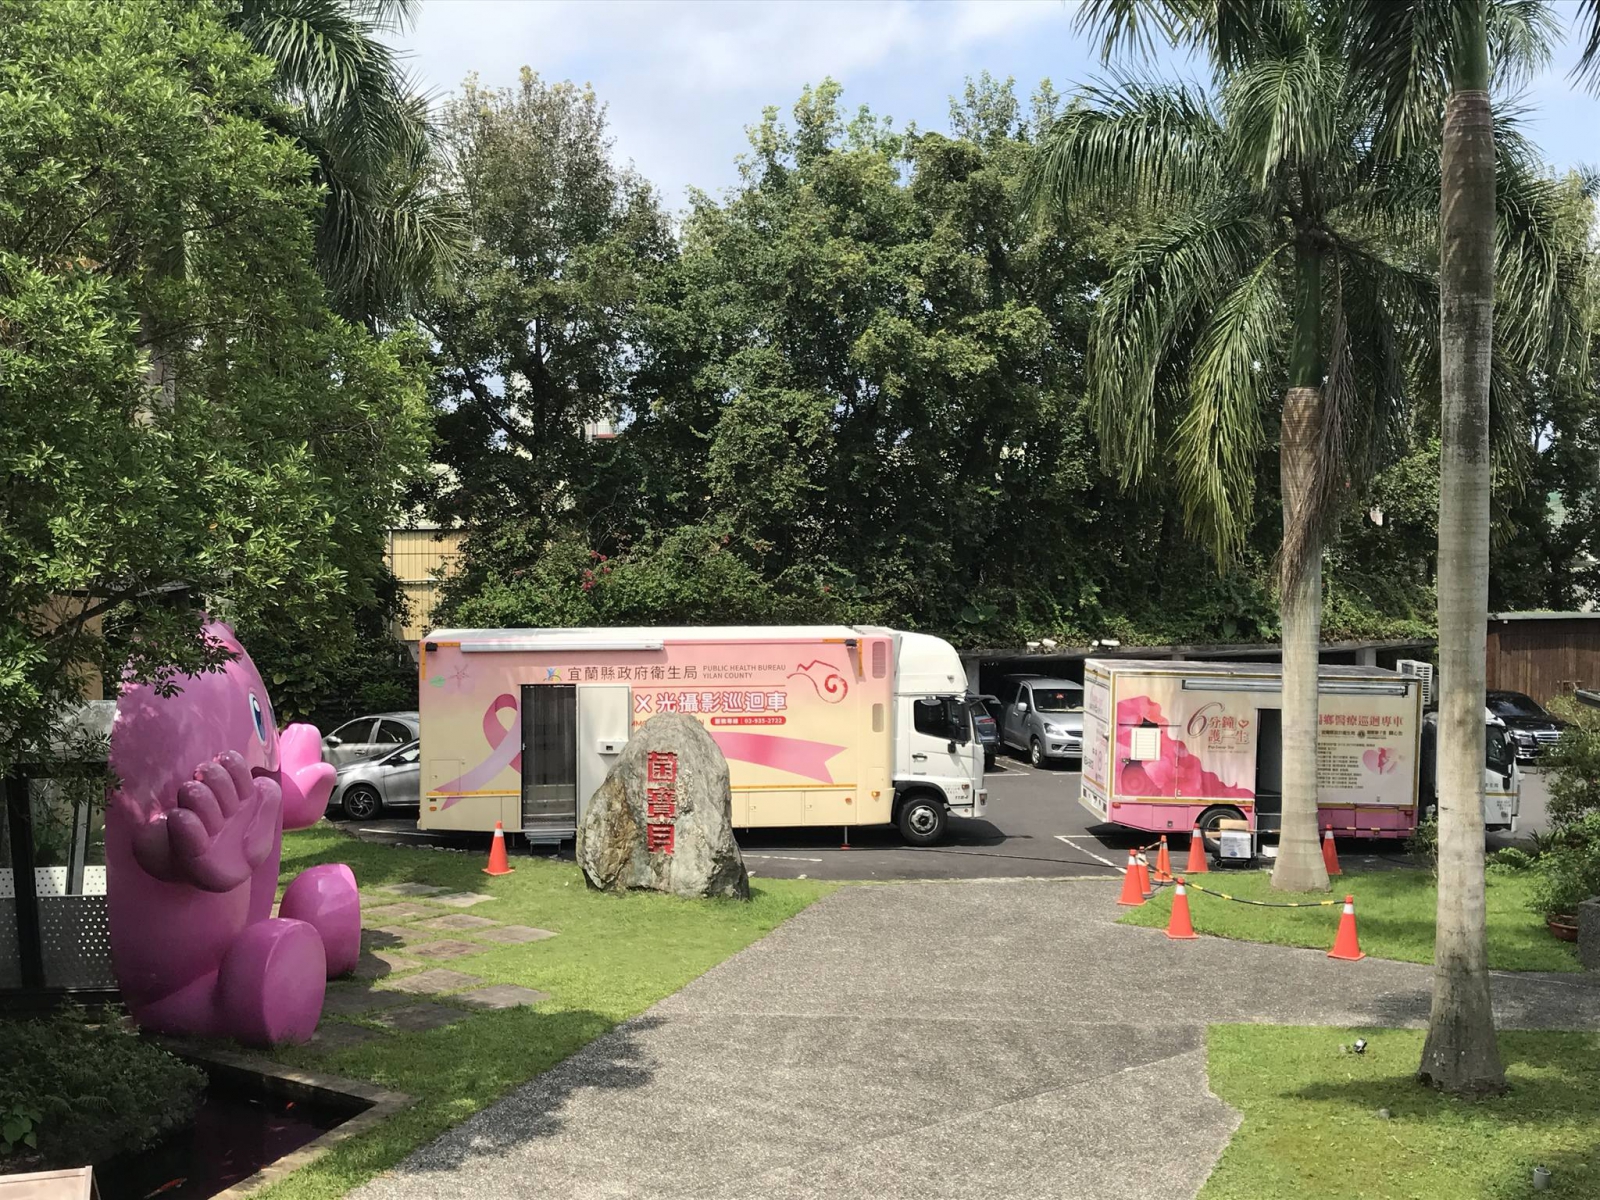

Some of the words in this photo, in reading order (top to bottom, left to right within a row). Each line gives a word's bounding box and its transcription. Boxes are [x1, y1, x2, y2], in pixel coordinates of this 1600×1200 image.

[568, 666, 698, 681] 宜蘭縣政府衛生局
